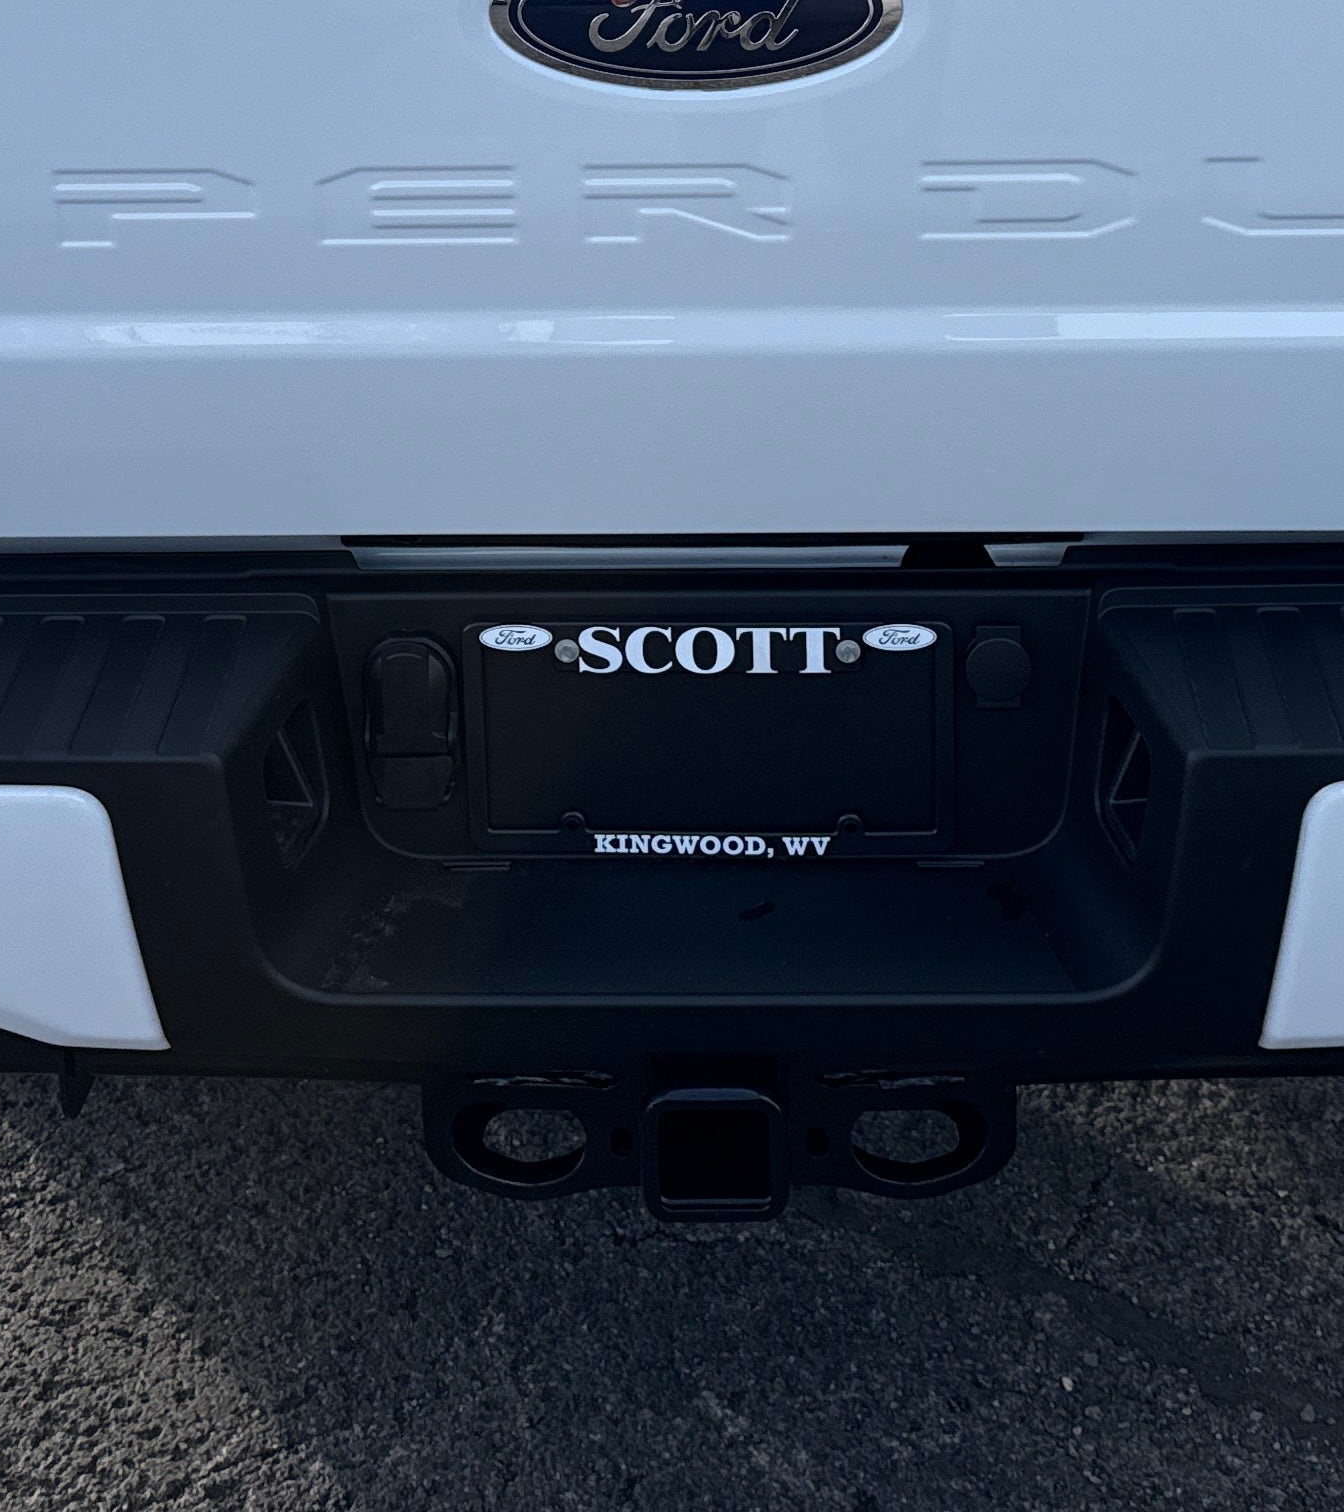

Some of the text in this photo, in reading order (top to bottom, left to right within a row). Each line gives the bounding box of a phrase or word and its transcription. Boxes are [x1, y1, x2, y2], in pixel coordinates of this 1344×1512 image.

[494, 628, 537, 646] Ford
[878, 628, 921, 646] Ford
[578, 626, 841, 674] SCOTT
[593, 833, 830, 858] KINGWOOD, WV
